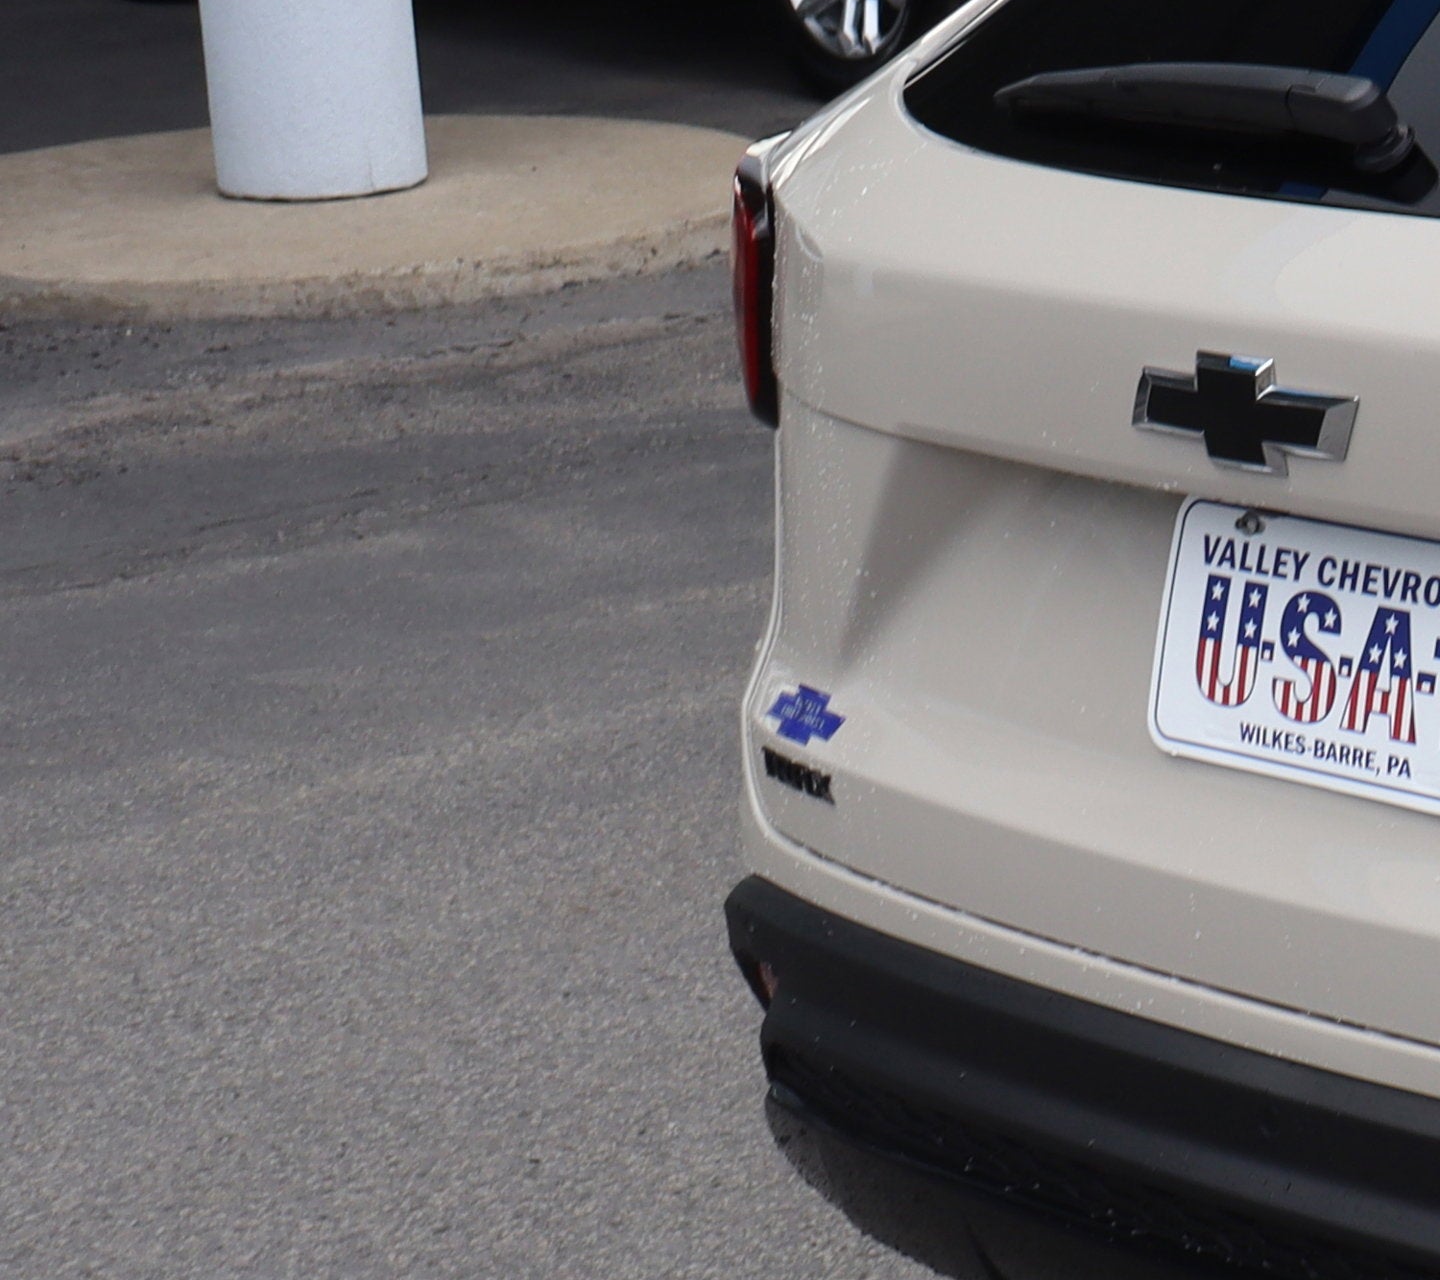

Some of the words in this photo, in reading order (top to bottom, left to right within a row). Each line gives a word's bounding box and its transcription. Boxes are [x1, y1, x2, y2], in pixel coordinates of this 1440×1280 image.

[1203, 533, 1310, 581] VALLEY
[1239, 721, 1381, 776] WILKES-BARRE,
[1386, 755, 1412, 779] PA
